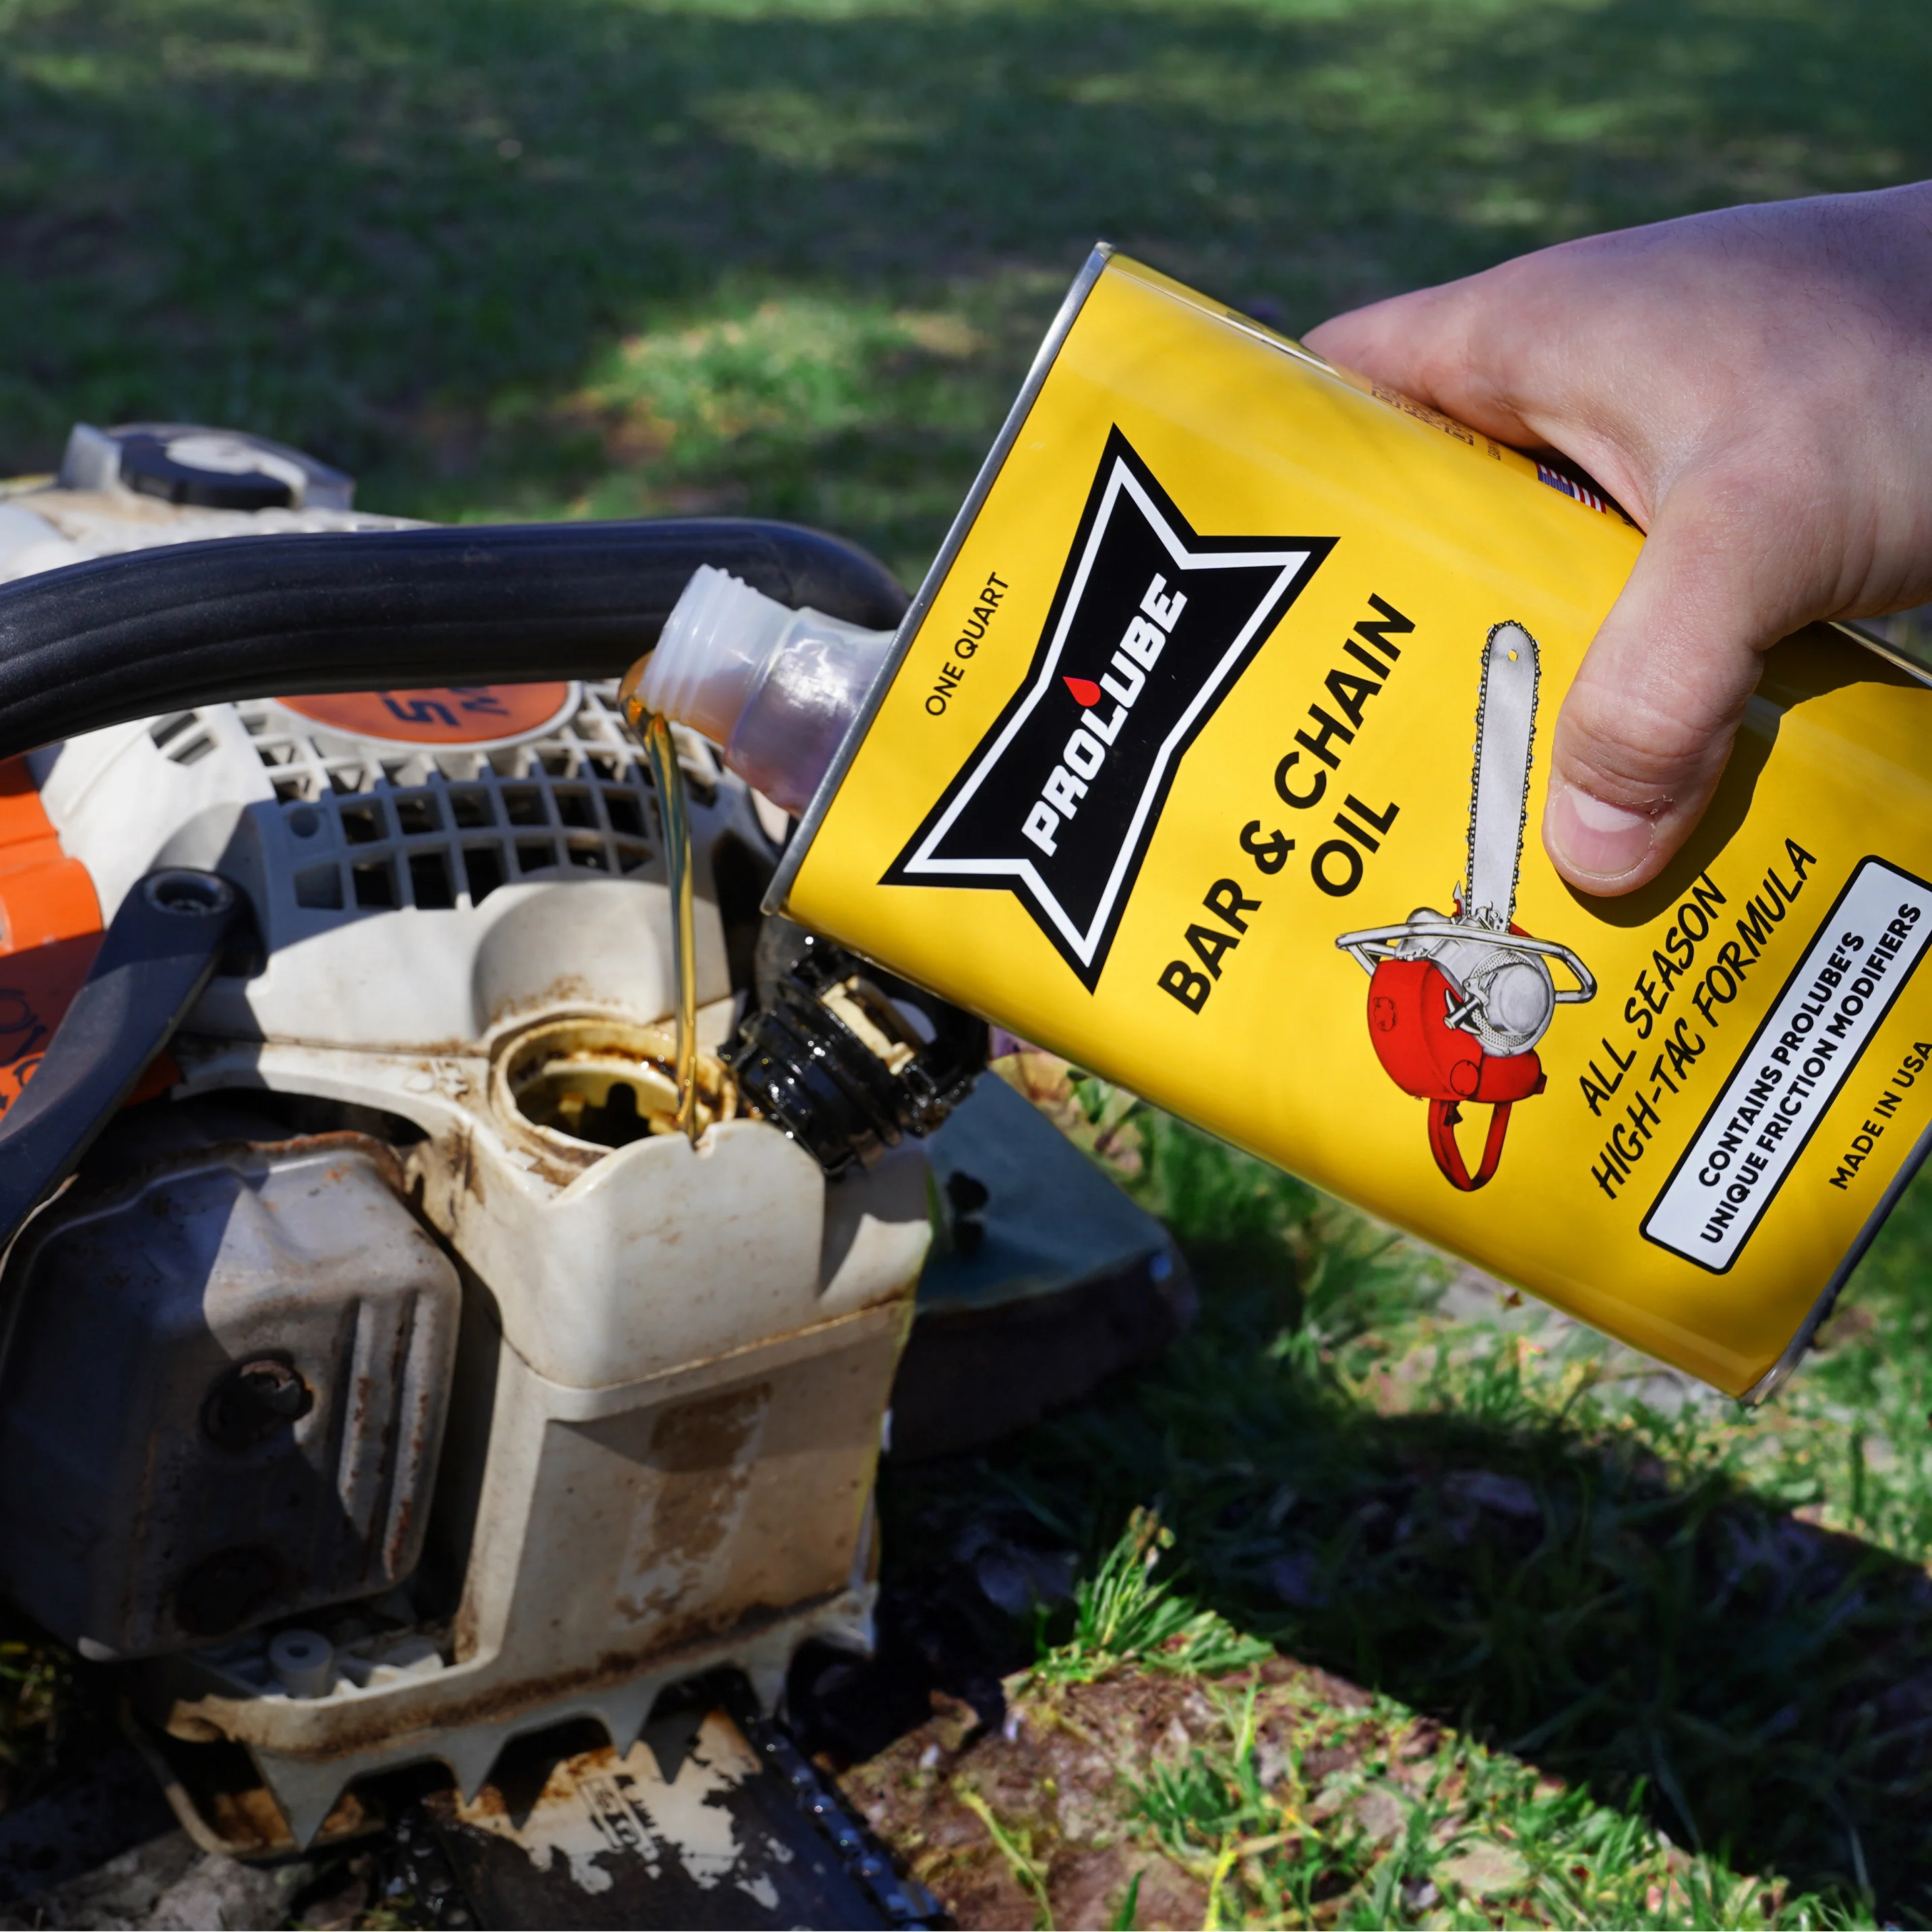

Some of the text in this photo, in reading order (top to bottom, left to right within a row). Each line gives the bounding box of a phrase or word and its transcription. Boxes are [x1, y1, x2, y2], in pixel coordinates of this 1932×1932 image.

[925, 572, 1008, 717] ONE QUART
[1021, 572, 1188, 857] PROLUBE
[1157, 593, 1416, 1015] BAR & CHAIN
[1310, 793, 1400, 897] OIL
[1579, 870, 1727, 1117] ALL SEASON
[1591, 837, 1817, 1200] HIGH-TAC FORMULA
[1698, 932, 1865, 1187] CONTAINS PROLUBE'S
[1700, 903, 1921, 1243] UNIQUE FRICTION MODIFIERS
[1828, 1042, 1932, 1190] MADE IN USA
